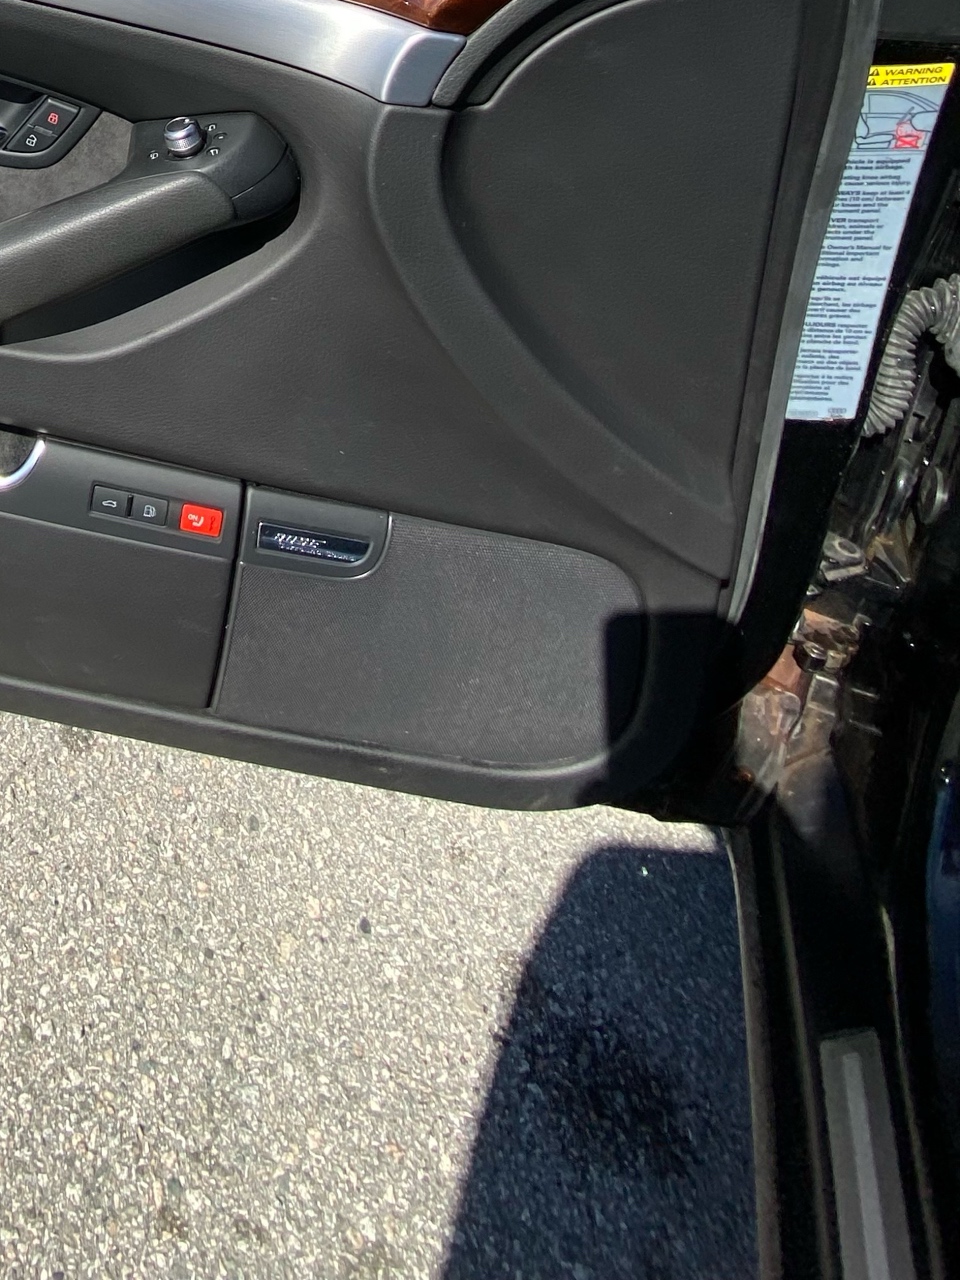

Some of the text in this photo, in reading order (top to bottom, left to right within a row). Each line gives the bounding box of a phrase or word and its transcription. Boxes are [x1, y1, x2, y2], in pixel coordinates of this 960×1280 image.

[885, 67, 944, 76] WARNING
[881, 76, 947, 86] ATTENTION
[188, 513, 198, 522] ON
